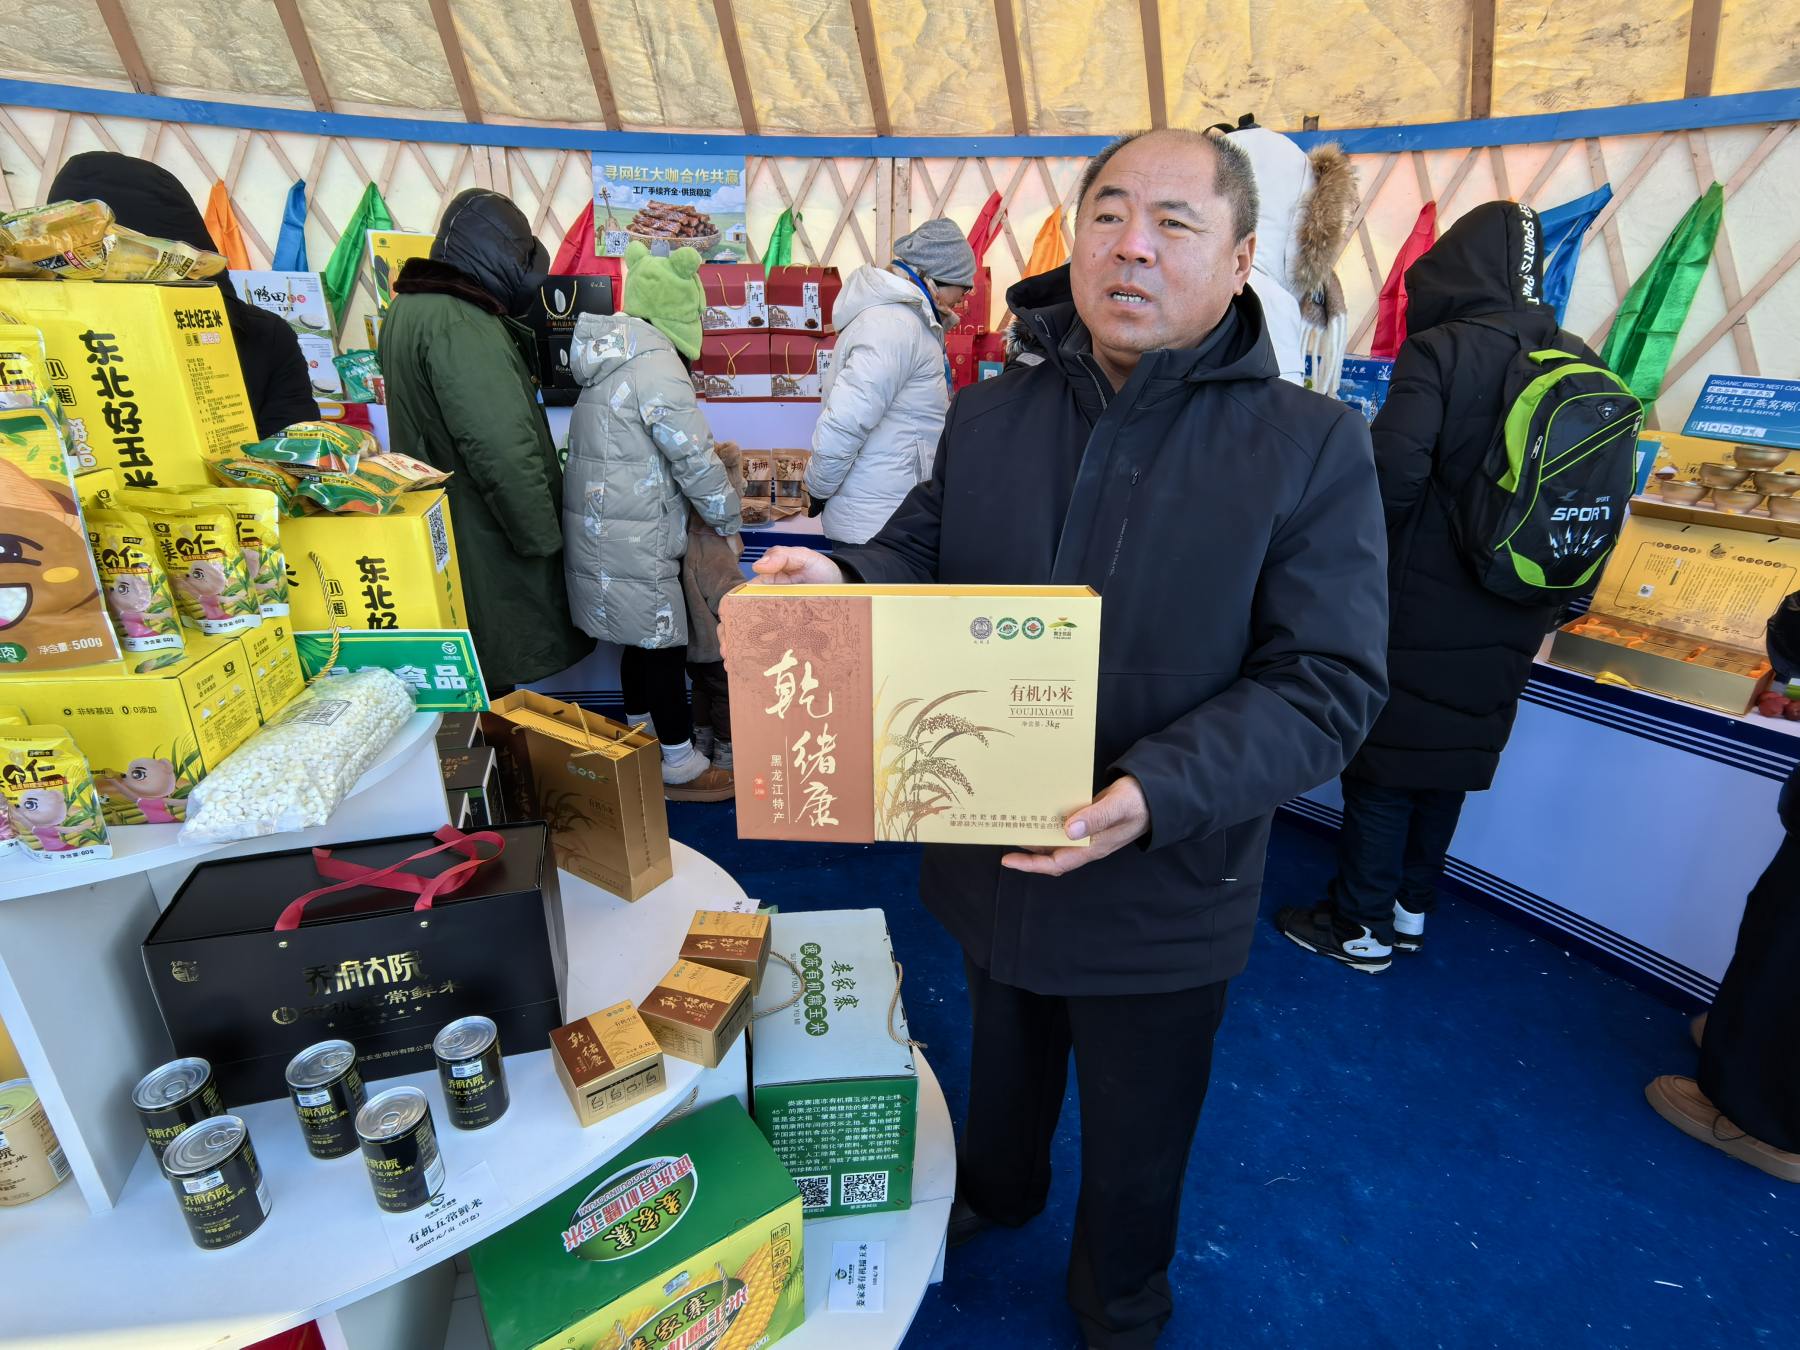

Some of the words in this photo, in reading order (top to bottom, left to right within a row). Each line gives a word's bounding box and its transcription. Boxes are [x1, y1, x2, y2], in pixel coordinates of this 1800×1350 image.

[604, 164, 741, 186] 寻网红大咖合作共赢
[1520, 220, 1535, 274] SPORTS
[174, 308, 223, 330] 东北好玉米
[1711, 379, 1742, 388] ORGANIC
[1766, 383, 1784, 391] NEST
[78, 329, 159, 489] 东北好玉米
[1550, 505, 1610, 522] SPORT
[355, 555, 400, 630] 东北好
[319, 664, 468, 690] 食品
[1009, 684, 1074, 703] 有机小米
[75, 706, 114, 716] 非转基因
[1009, 706, 1074, 718] YOUJIXIAOMI
[763, 648, 841, 829] 乾绪康
[769, 754, 786, 825] 黑龙江特产
[302, 950, 432, 998] 乔府大院
[801, 942, 829, 1036] 速冻有机糯玉米
[183, 1183, 233, 1206] 乔府大院
[562, 1153, 694, 1253] 速冻有机糯玉米
[407, 1198, 484, 1245] 有机五常鲜米
